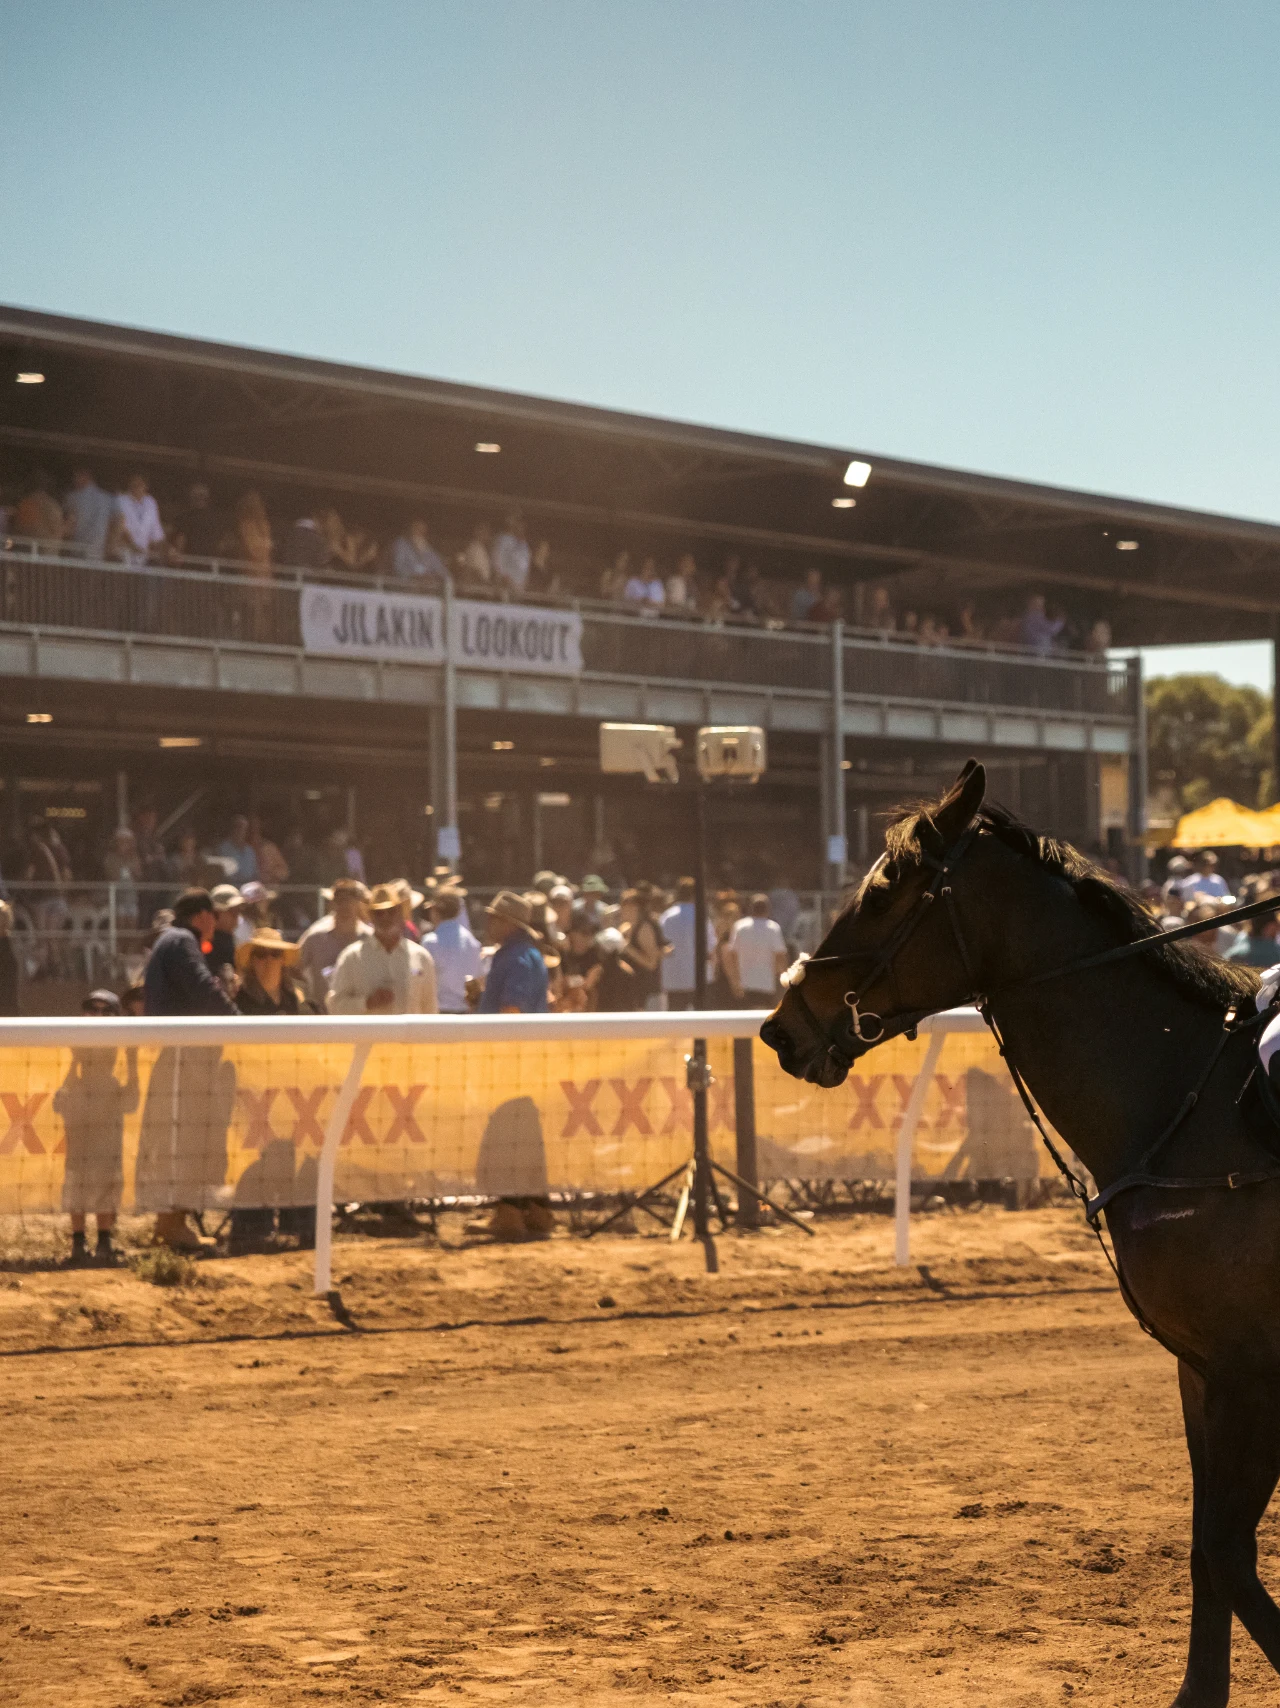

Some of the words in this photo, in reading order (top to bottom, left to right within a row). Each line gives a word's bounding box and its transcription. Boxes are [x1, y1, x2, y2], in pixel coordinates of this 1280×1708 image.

[333, 602, 433, 648] JILAKIN
[461, 613, 570, 661] LOOKOUT
[848, 1073, 1012, 1129] XXX
